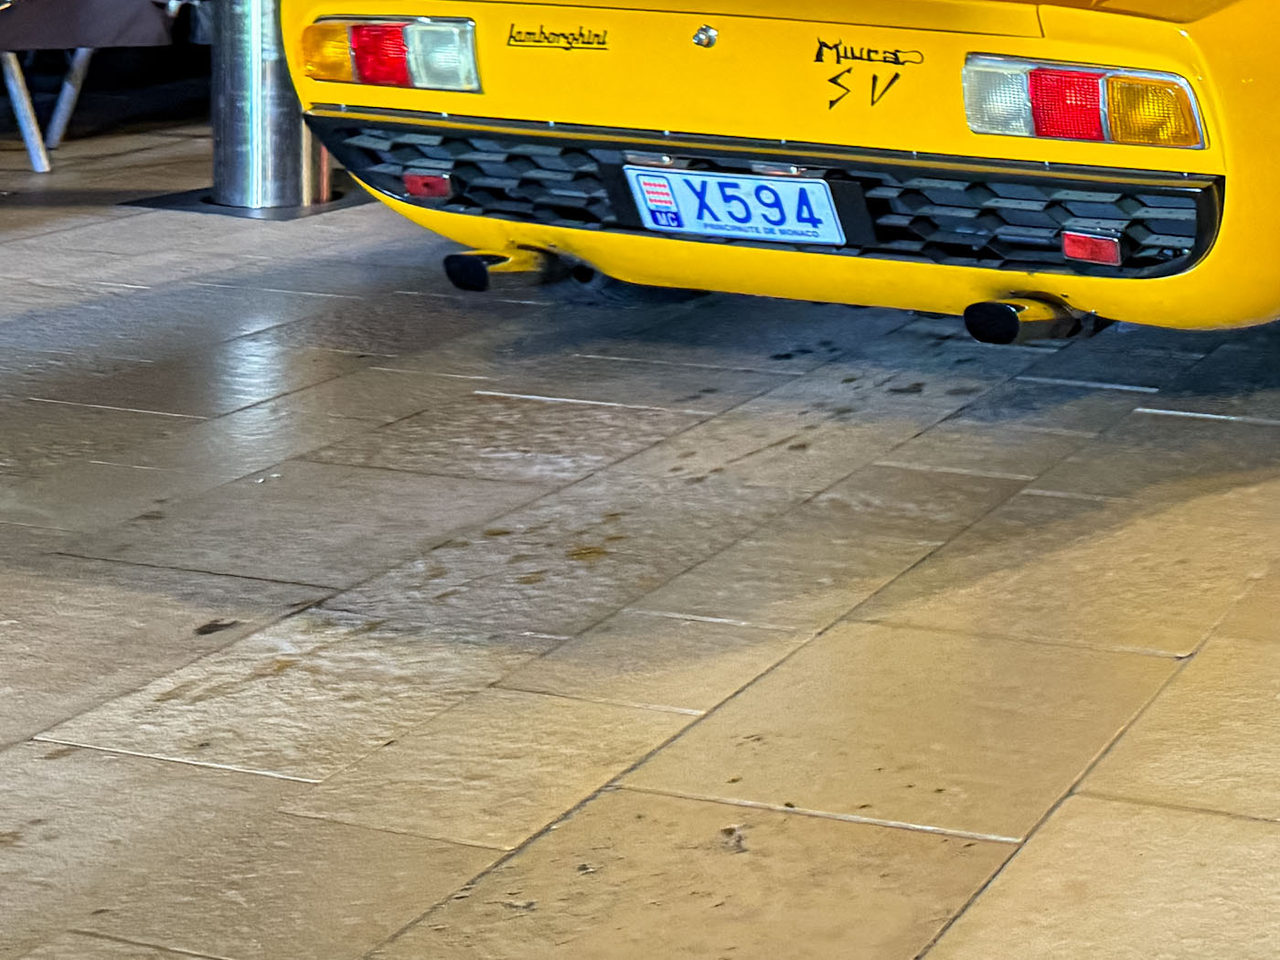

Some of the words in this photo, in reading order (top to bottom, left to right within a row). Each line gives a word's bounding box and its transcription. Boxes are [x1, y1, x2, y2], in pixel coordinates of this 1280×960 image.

[814, 37, 924, 66] Miura
[683, 178, 823, 229] X594
[655, 212, 679, 227] MC
[763, 227, 776, 235] DE
[779, 229, 820, 238] MONACO
